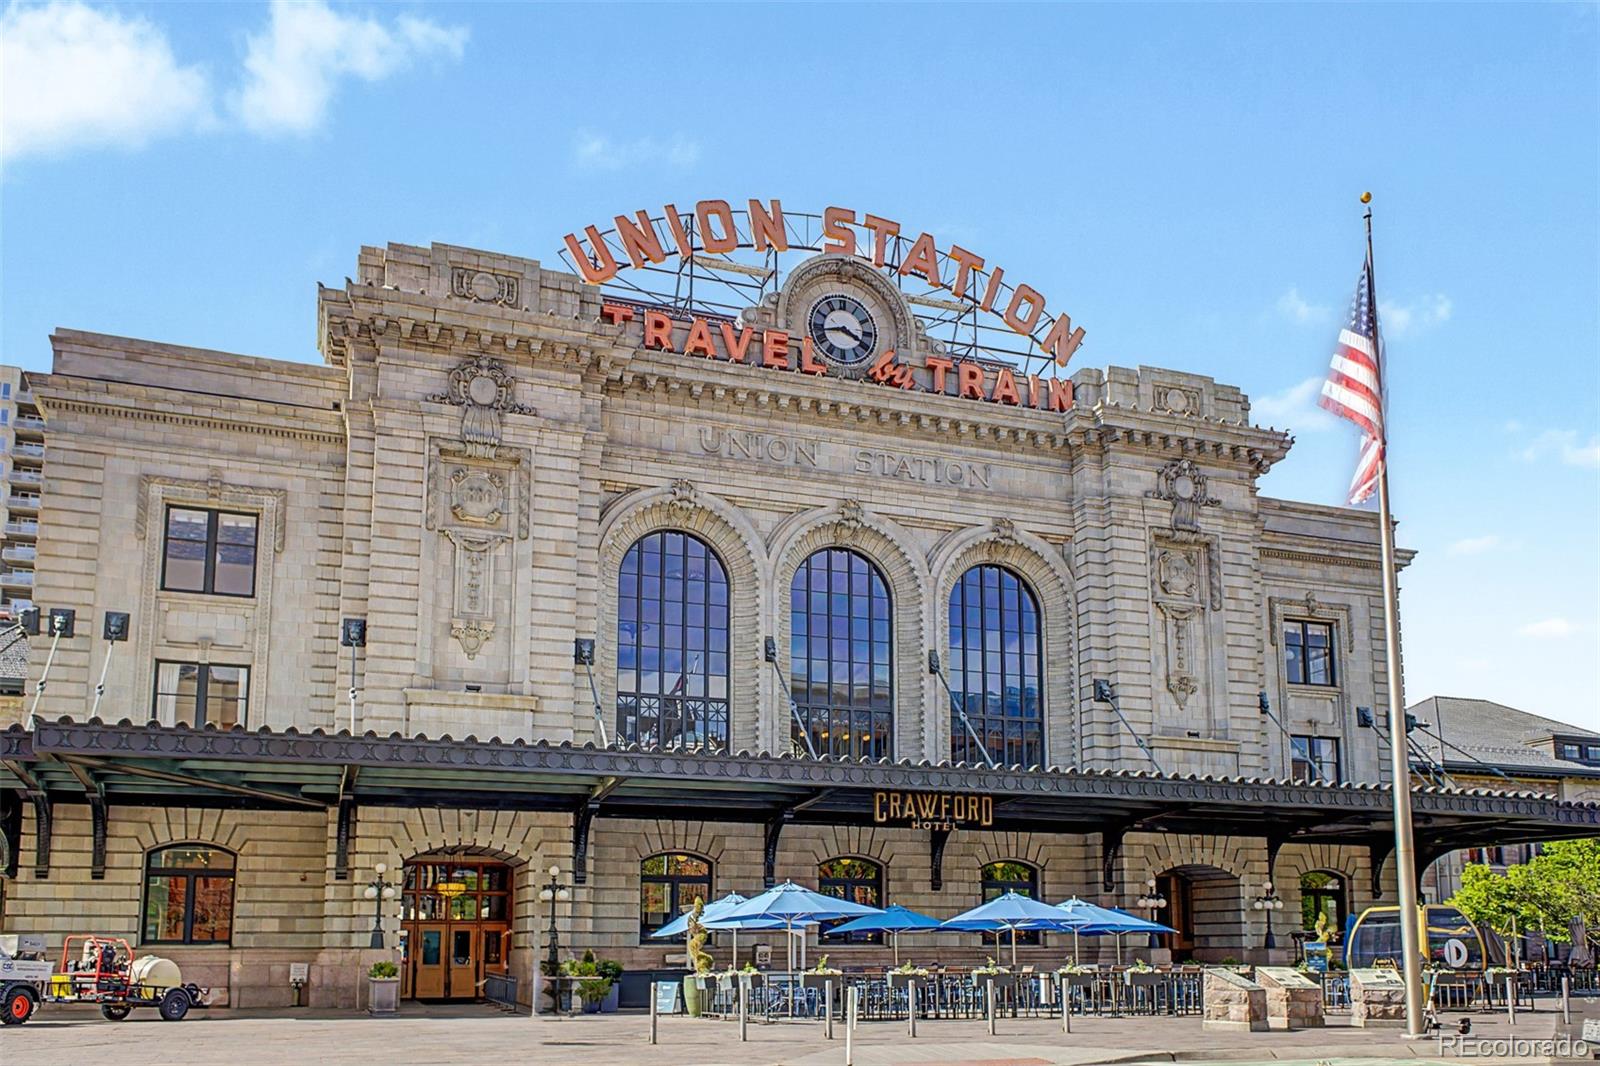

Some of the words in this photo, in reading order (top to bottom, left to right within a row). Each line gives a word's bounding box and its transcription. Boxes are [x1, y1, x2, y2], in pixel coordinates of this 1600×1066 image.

[563, 199, 787, 285] UNION
[823, 206, 1085, 367] STATION
[602, 304, 827, 374] TRAVEL
[868, 349, 916, 390] by
[926, 356, 1073, 412] TRAIN
[699, 427, 817, 467] UNION
[855, 451, 990, 488] STATION
[874, 792, 993, 826] CRAWFORD
[912, 821, 960, 831] HOTEL
